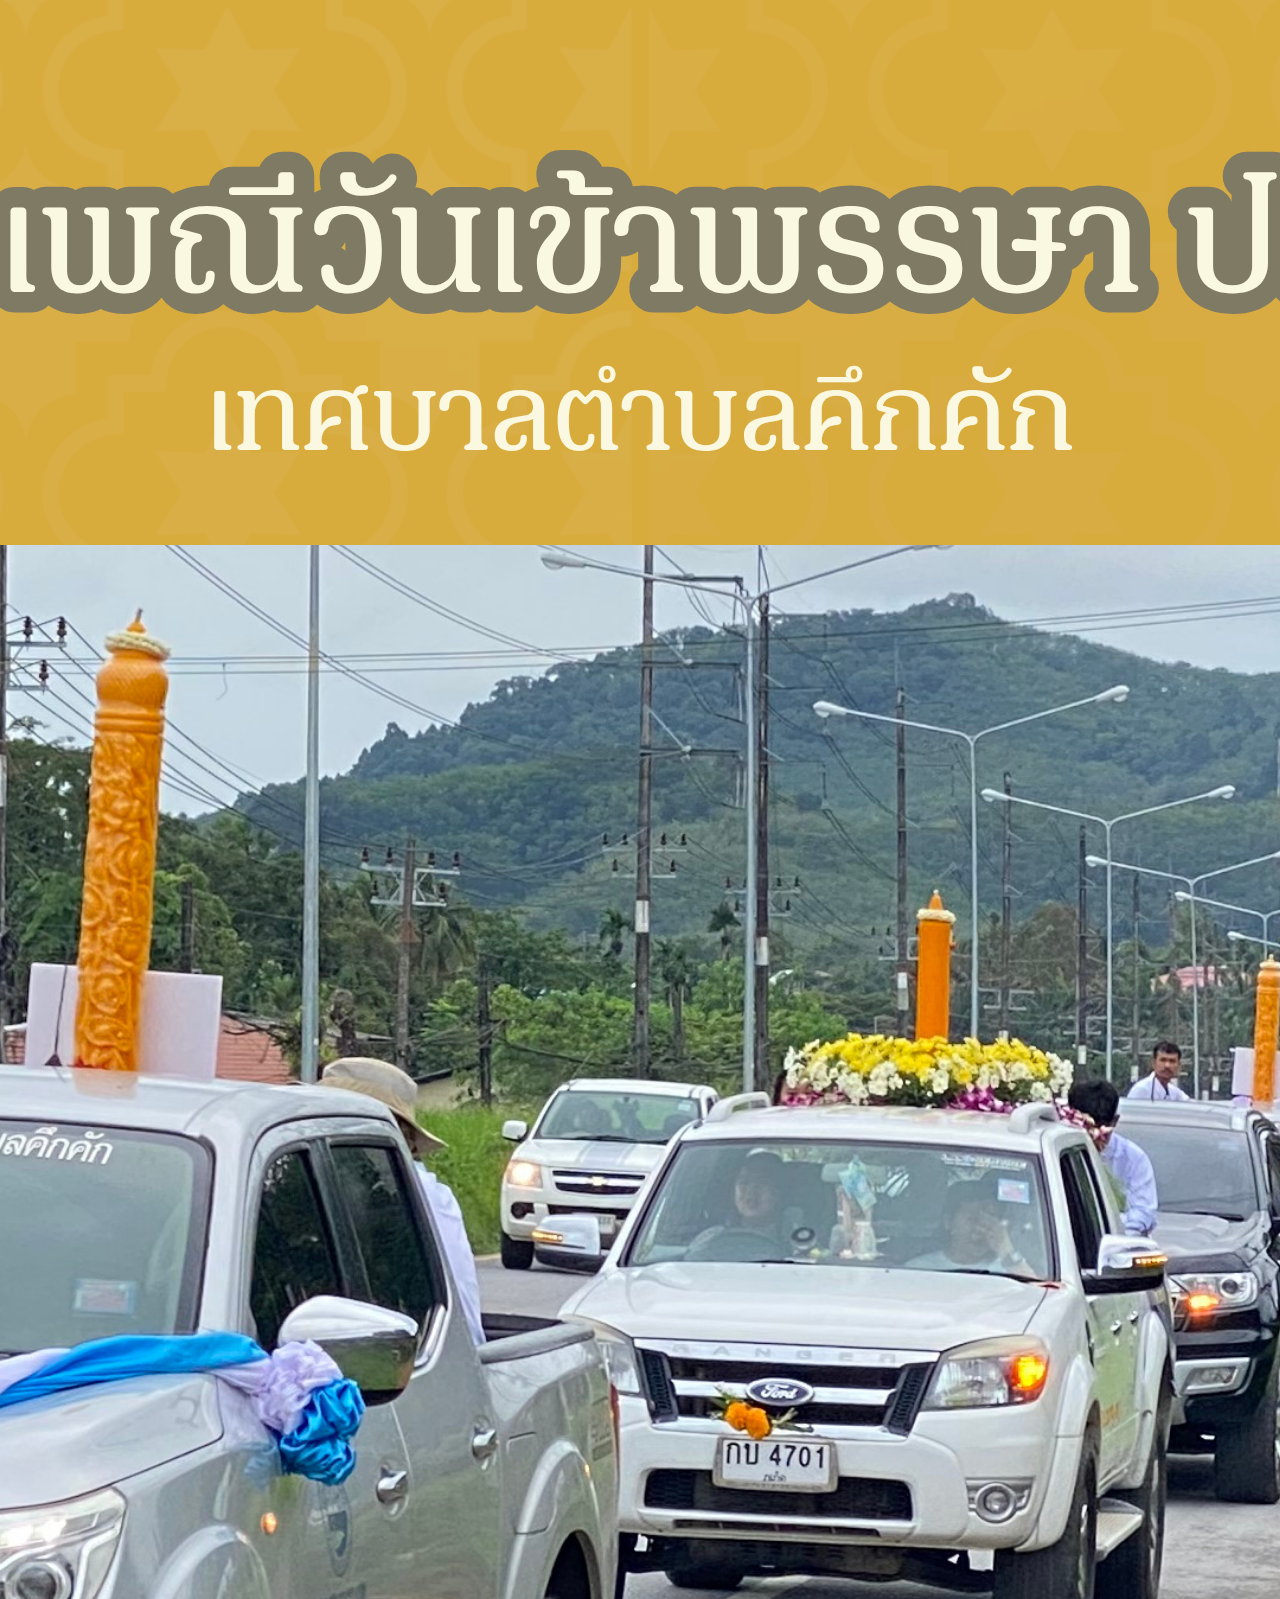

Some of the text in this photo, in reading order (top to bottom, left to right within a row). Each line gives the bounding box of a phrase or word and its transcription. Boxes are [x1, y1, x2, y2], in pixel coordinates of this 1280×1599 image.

[673, 1343, 897, 1364] RANGER
[760, 1383, 798, 1400] Ford
[769, 1444, 824, 1469] 4701
